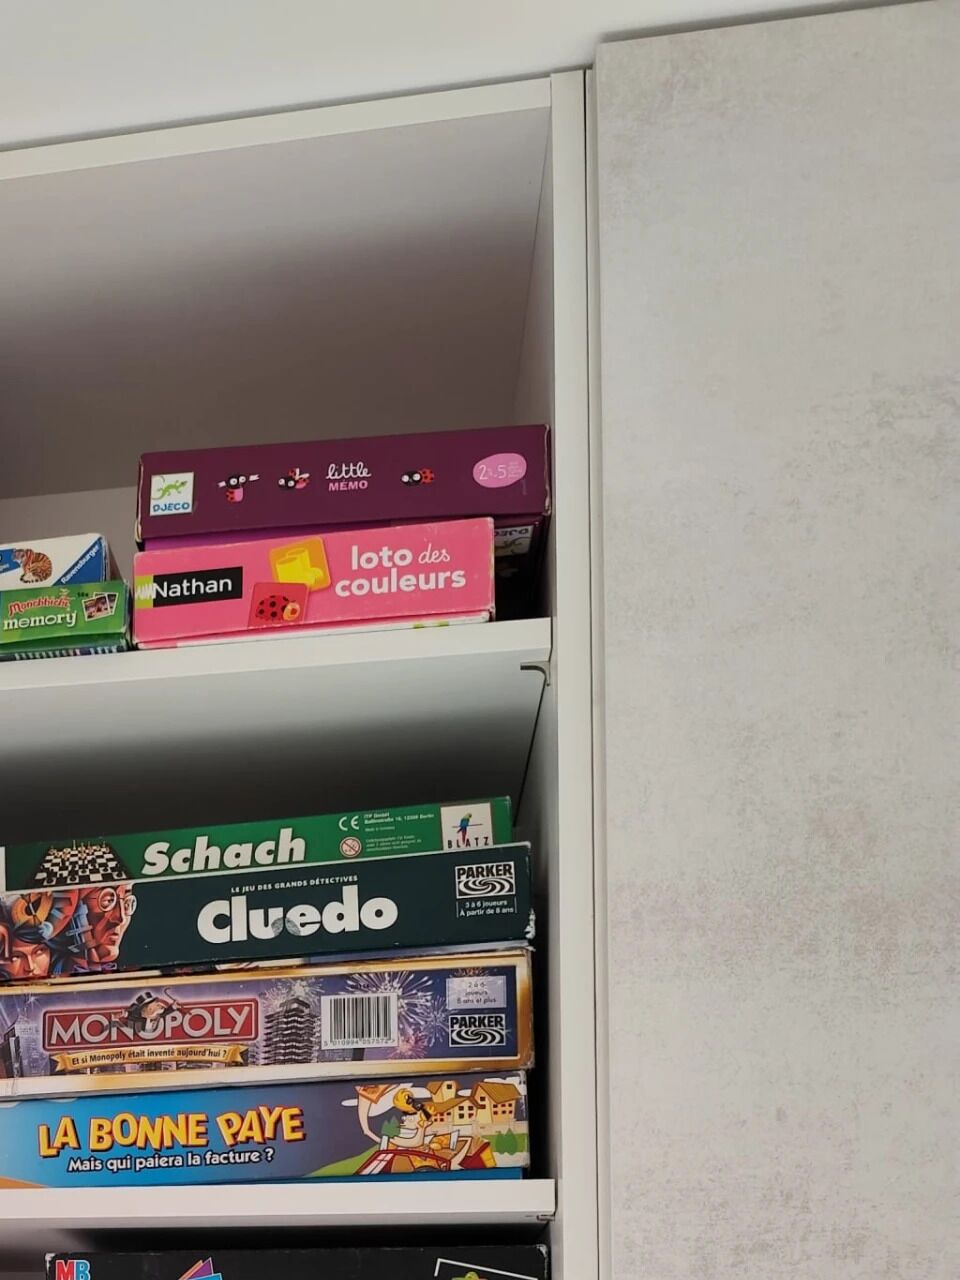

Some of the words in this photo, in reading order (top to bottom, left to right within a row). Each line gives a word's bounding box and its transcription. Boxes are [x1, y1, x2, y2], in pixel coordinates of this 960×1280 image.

[325, 462, 372, 480] little
[152, 502, 190, 513] DJECO
[60, 544, 100, 585] Ravensburger
[352, 545, 413, 570] loto
[418, 543, 451, 565] des
[151, 575, 233, 600] Nathan
[334, 567, 466, 598] couleurs
[3, 610, 77, 630] memory
[141, 828, 306, 875] Schach
[448, 836, 489, 849] BLATZ
[457, 864, 513, 880] PARKER
[242, 885, 255, 893] JEU
[257, 883, 272, 891] DES
[275, 880, 308, 889] GRANDS
[309, 875, 358, 886] DÉTECTIVES
[466, 908, 485, 917] partir
[483, 900, 508, 908] joueurs
[197, 885, 399, 944] Cluedo
[50, 1006, 250, 1045] MONOPOLY
[450, 1016, 503, 1029] PARKER
[72, 1058, 80, 1066] Et
[90, 1052, 126, 1065] Monopoly
[128, 1049, 145, 1058] était
[147, 1048, 175, 1057] inventé
[176, 1048, 220, 1060] aujourd'hui
[222, 1049, 227, 1057] ?
[38, 1116, 81, 1158] LA
[89, 1112, 209, 1152] BONNE
[216, 1104, 307, 1146] PAYE
[68, 1158, 103, 1172] Mais
[105, 1156, 131, 1173] qui
[136, 1154, 183, 1172] paiera
[188, 1153, 200, 1166] la
[204, 1149, 260, 1165] facture
[265, 1148, 275, 1162] ?
